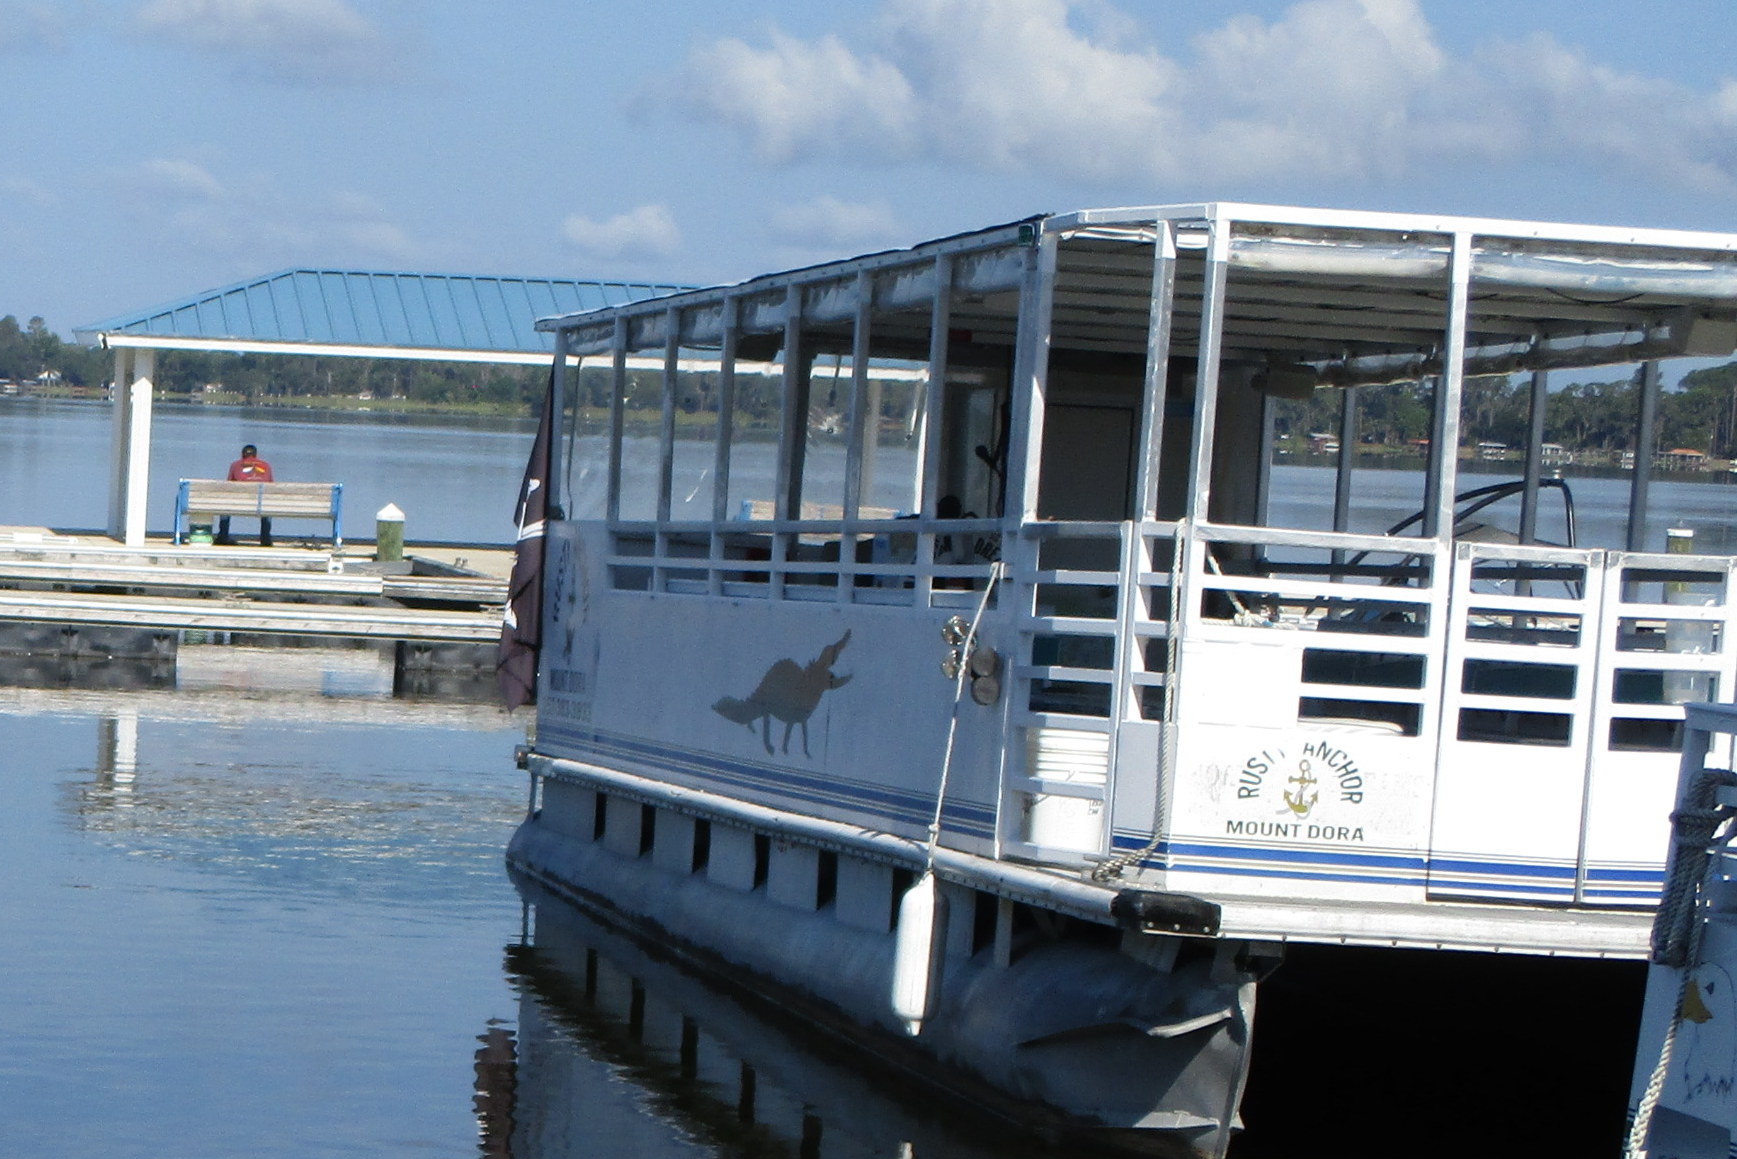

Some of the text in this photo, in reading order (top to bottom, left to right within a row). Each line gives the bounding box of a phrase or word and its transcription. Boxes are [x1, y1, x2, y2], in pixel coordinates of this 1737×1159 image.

[1302, 740, 1364, 805] ANCHOR
[1225, 820, 1365, 842] MOUNT DORA
